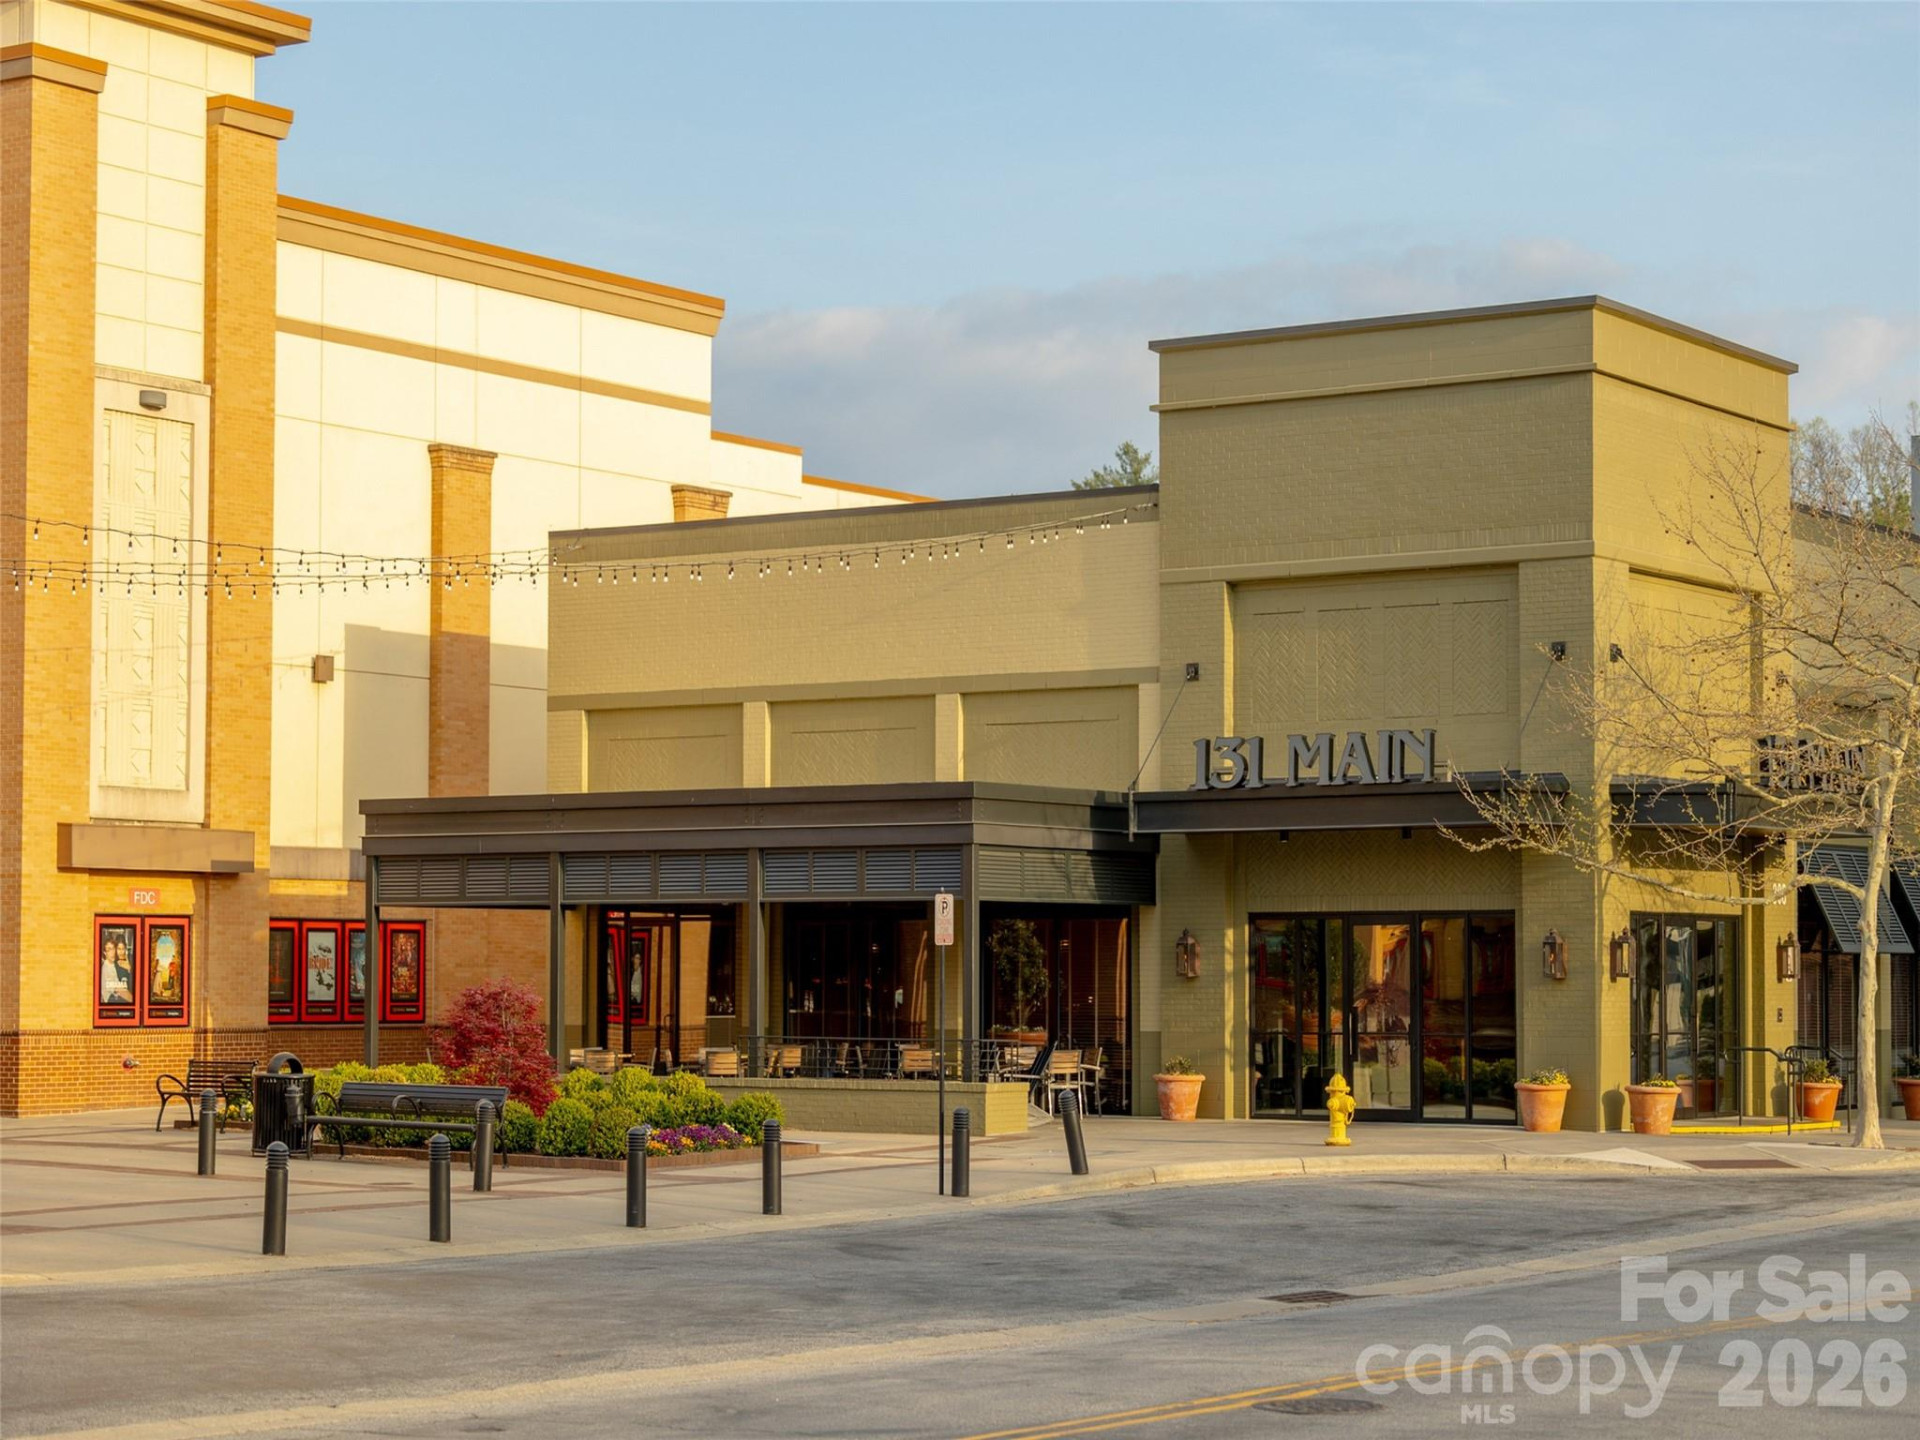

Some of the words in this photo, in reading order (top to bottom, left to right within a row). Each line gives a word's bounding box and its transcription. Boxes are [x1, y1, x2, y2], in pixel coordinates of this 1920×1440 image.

[1189, 736, 1264, 790] 131
[1286, 729, 1437, 788] MAIN
[134, 891, 156, 905] FDC
